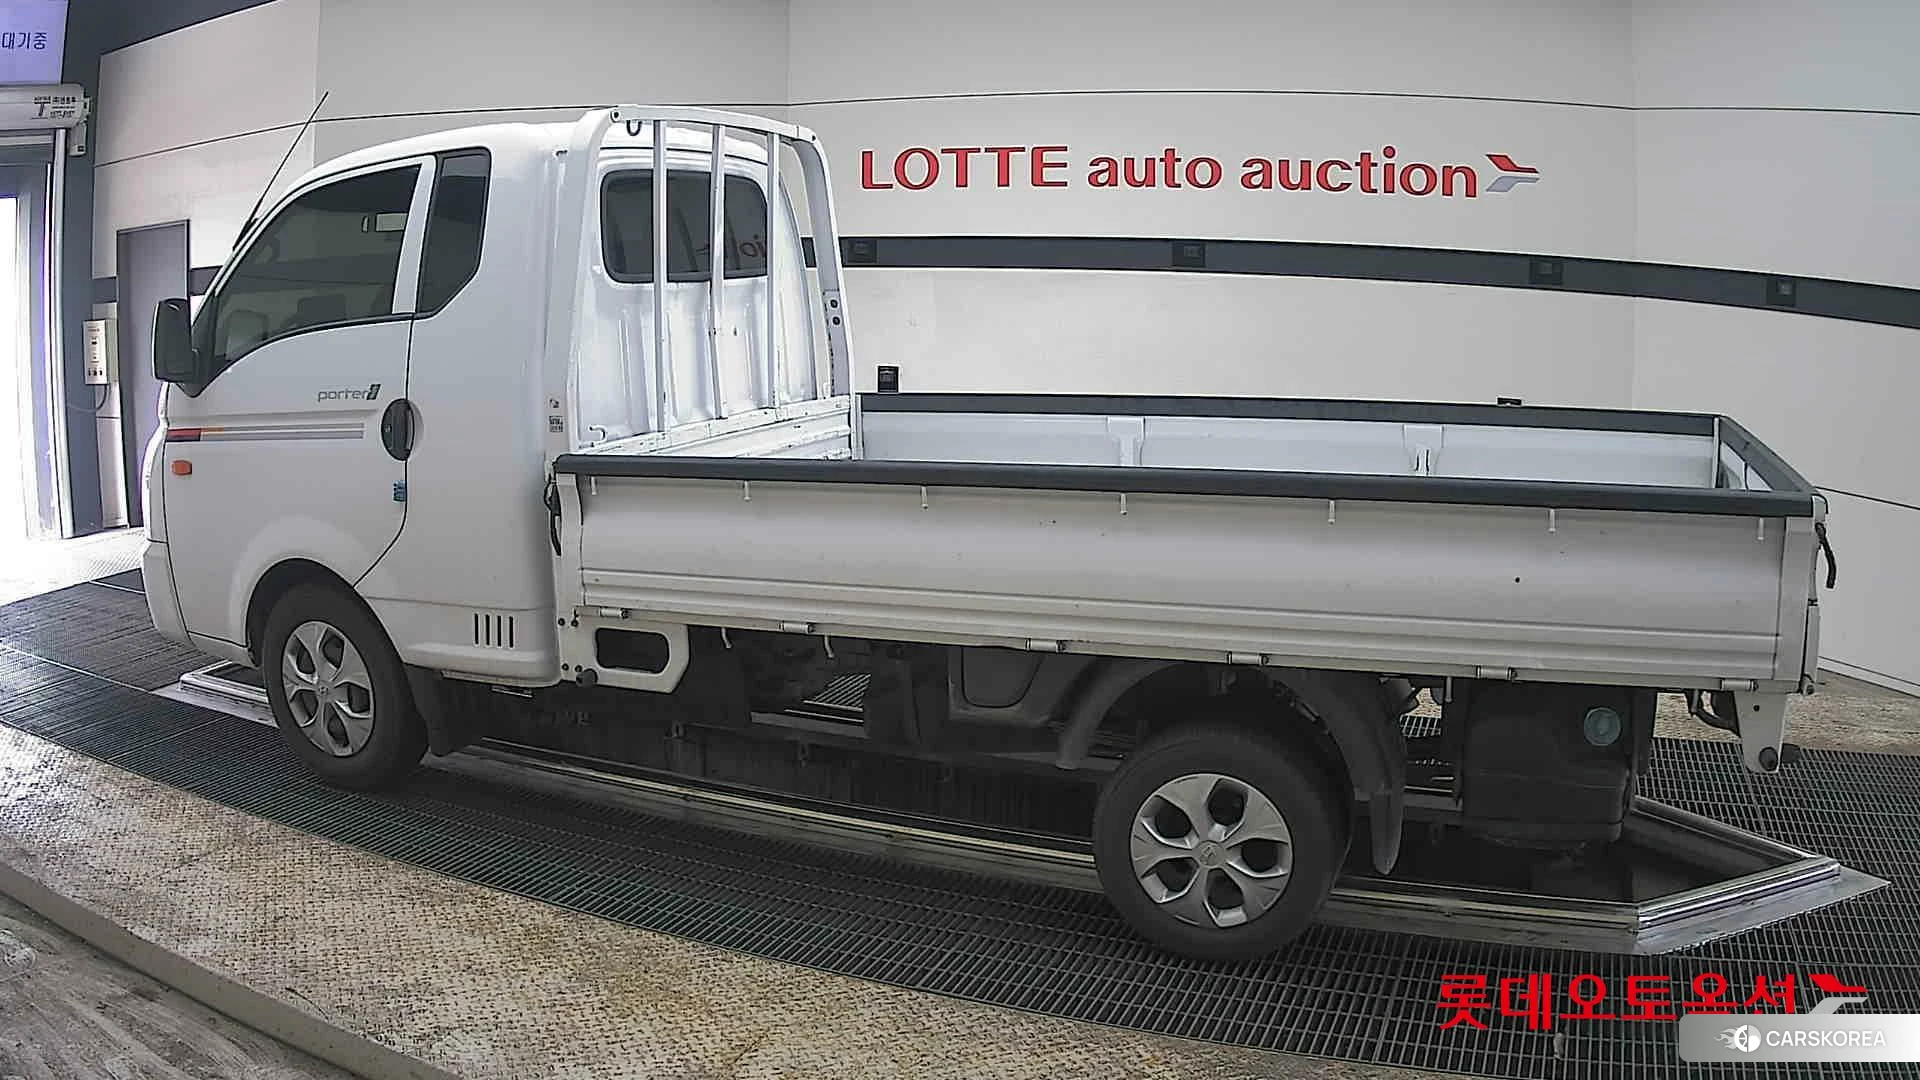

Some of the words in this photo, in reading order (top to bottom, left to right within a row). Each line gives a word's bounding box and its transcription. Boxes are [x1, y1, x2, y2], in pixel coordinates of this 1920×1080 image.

[1, 31, 48, 50] 대기중
[861, 145, 1069, 191] LOTTE
[1087, 148, 1223, 190] auto
[1240, 145, 1478, 199] auction
